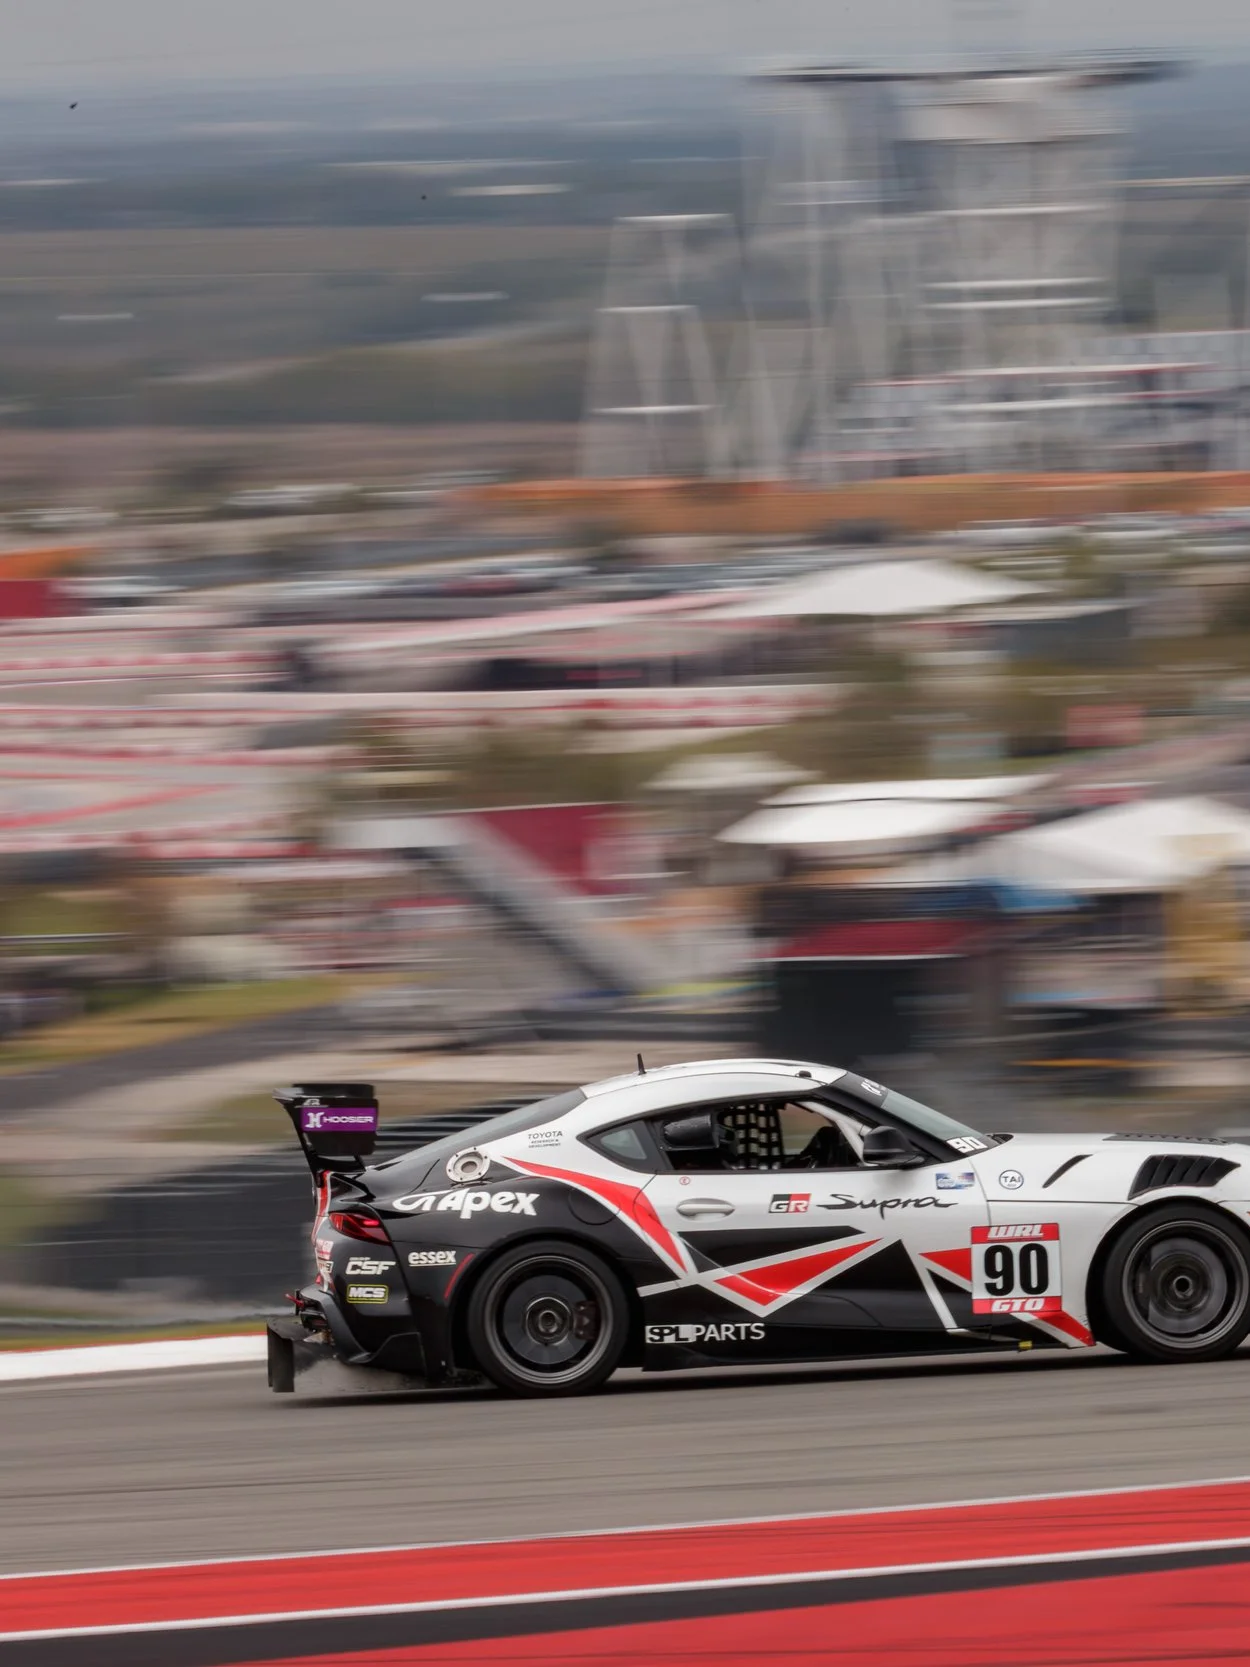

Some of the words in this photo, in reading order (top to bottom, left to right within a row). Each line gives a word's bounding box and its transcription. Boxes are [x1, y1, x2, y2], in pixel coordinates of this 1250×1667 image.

[323, 1116, 374, 1124] HOOSIER
[528, 1130, 563, 1140] TOYOTA
[946, 1136, 989, 1154] 90
[770, 1200, 810, 1213] GR
[816, 1193, 959, 1220] Supra
[987, 1225, 1044, 1239] WRL
[408, 1250, 457, 1265] essex
[345, 1261, 396, 1275] CSF
[984, 1243, 1049, 1297] 90
[348, 1286, 386, 1298] MCS
[991, 1298, 1045, 1312] GTO
[647, 1326, 690, 1343] SPL
[693, 1323, 766, 1342] PARTS
